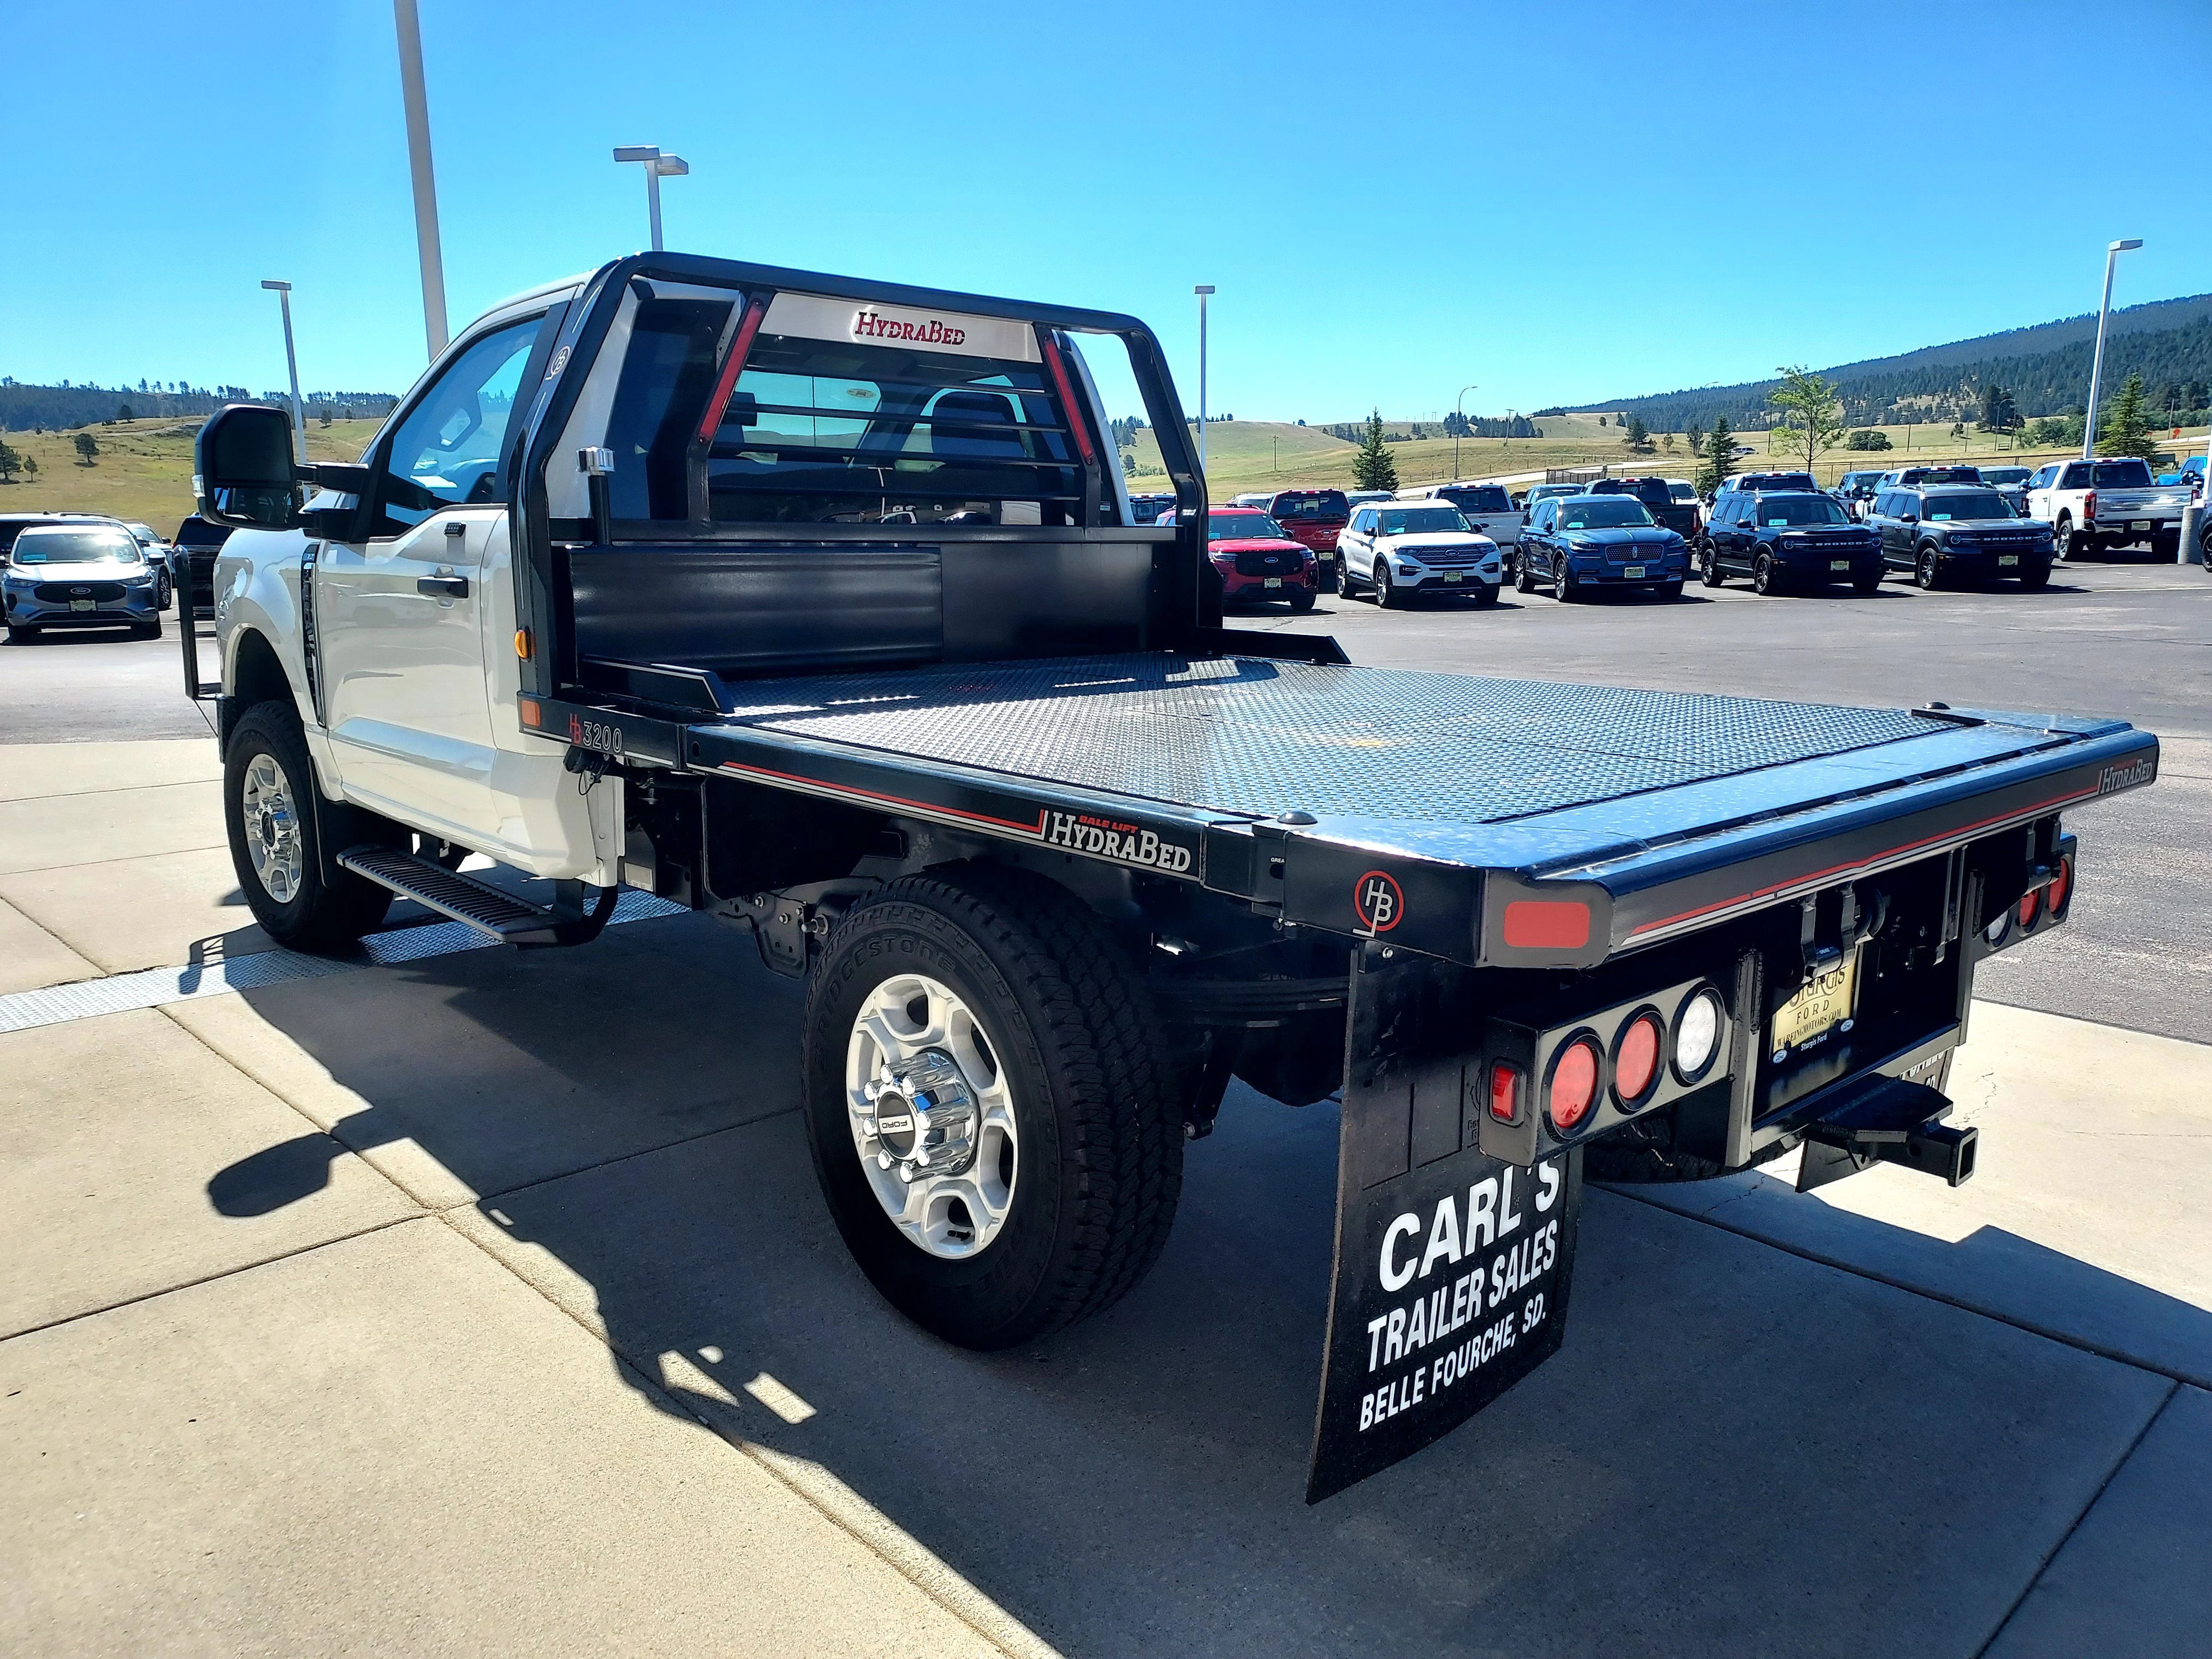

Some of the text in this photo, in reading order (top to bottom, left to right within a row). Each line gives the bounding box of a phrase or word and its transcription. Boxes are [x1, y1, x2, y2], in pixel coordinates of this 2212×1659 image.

[583, 721, 622, 753] 3200
[1079, 815, 1139, 834] BALE LIFT
[1796, 999, 1830, 1025] FORD
[1801, 1032, 1827, 1051] Sturgis Ford
[881, 1120, 907, 1128] FORD
[1367, 1219, 1557, 1373] TRAILER SALES
[1359, 1292, 1546, 1432] BELLE FOURCHE, SD.
